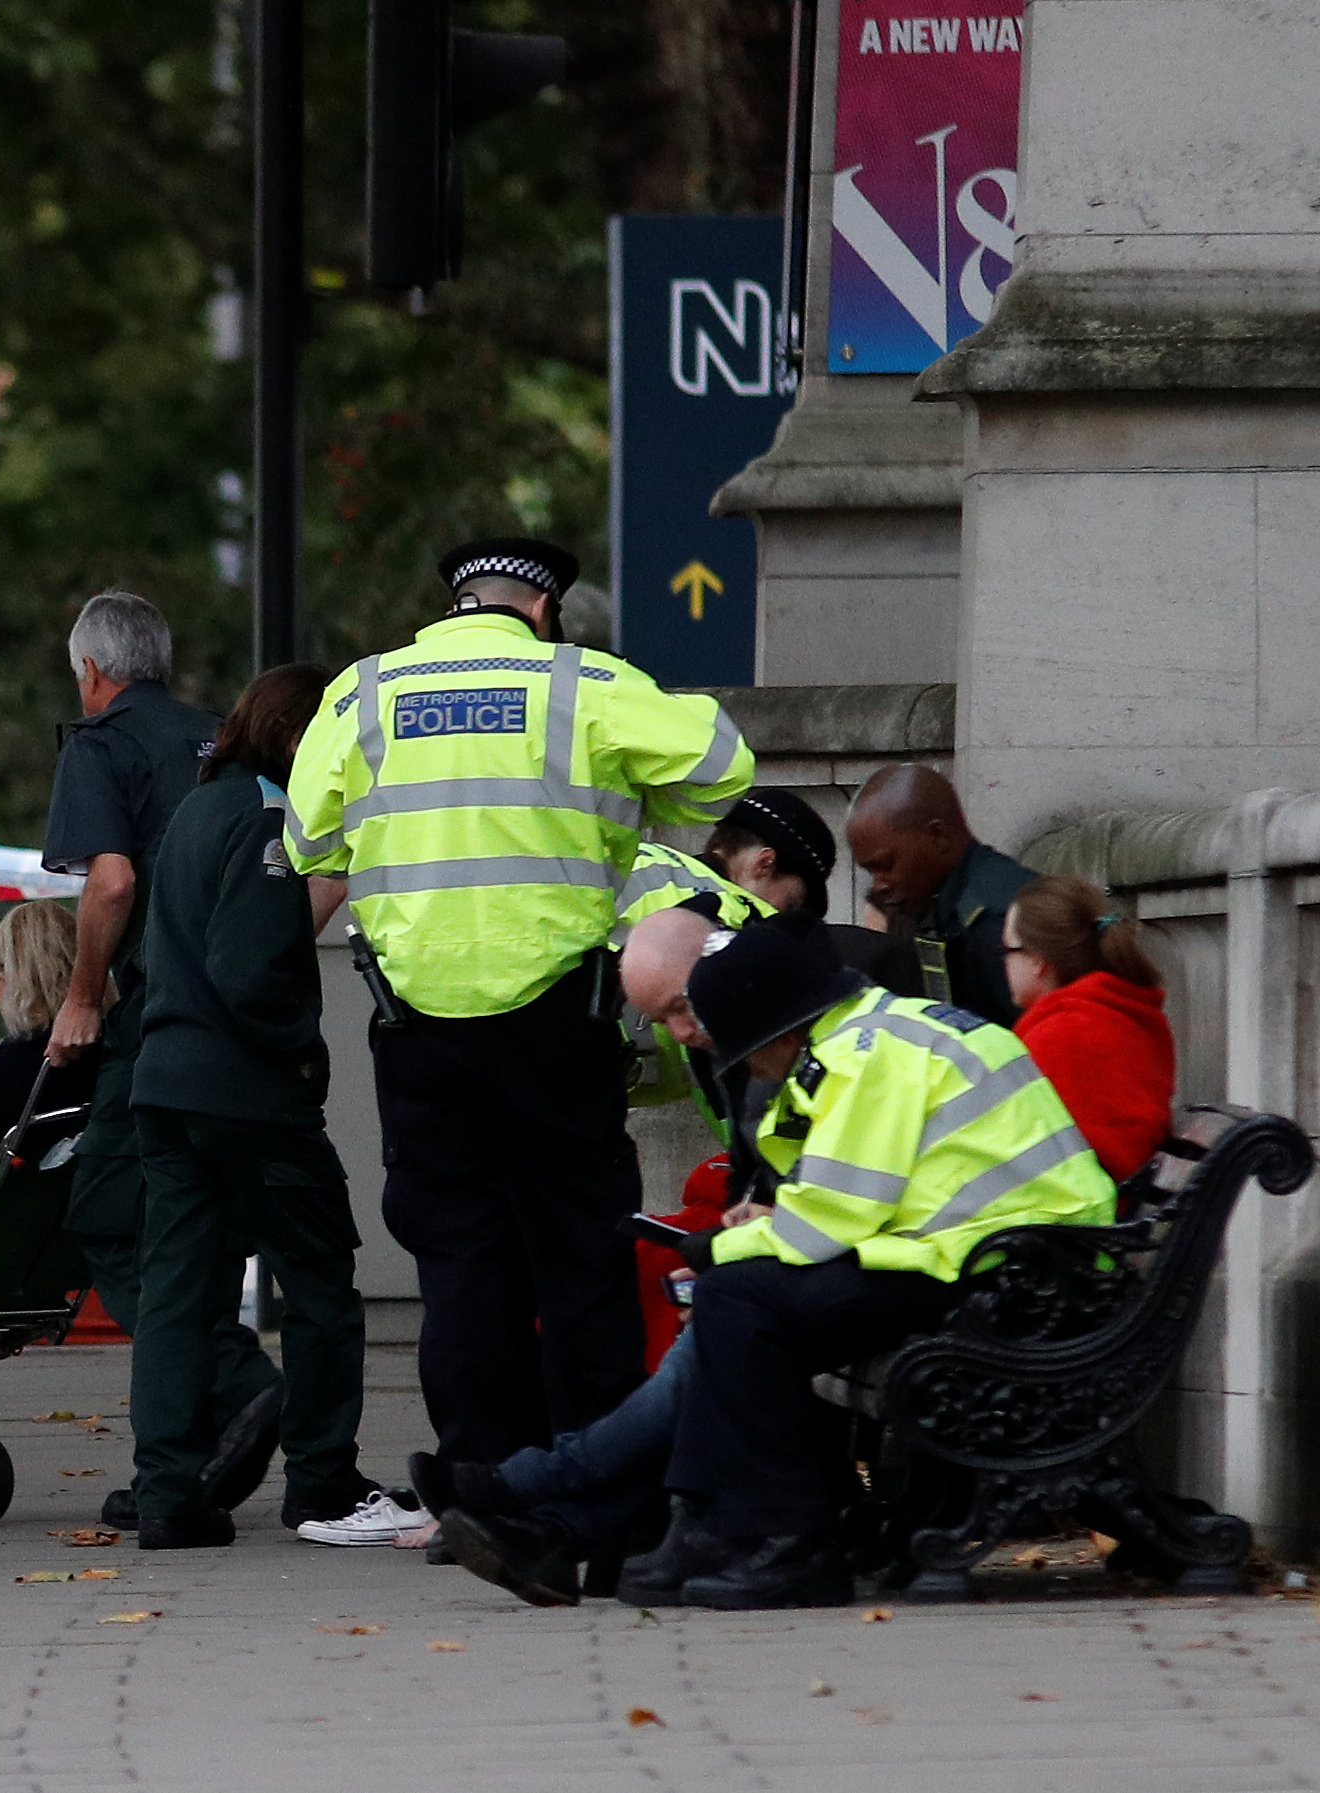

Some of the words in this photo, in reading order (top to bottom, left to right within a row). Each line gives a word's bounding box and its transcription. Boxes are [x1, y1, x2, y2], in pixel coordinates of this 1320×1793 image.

[859, 17, 882, 53] A
[889, 17, 961, 53] NEW
[397, 690, 525, 708] METROPOLITAN
[396, 705, 524, 736] POLICE
